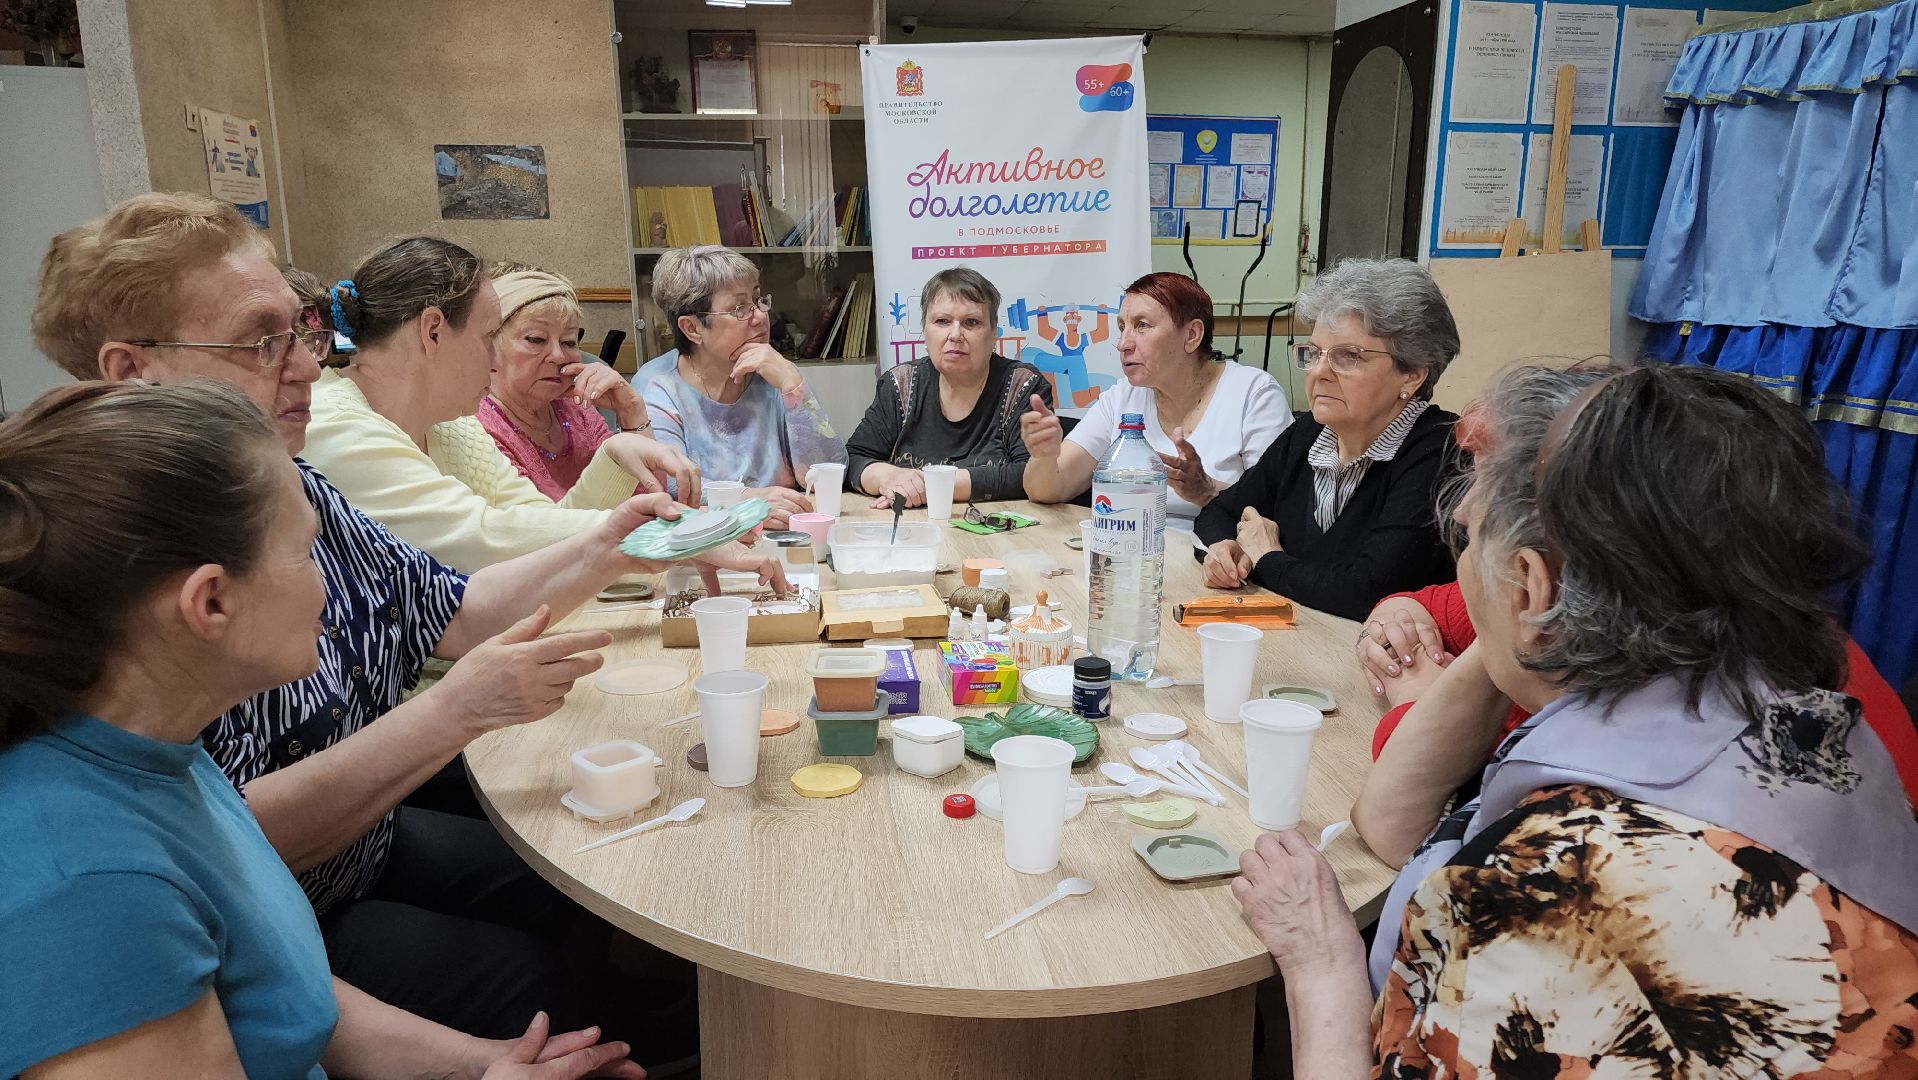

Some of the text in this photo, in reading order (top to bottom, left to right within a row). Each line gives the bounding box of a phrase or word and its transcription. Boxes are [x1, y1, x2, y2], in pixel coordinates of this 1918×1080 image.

[1084, 79, 1105, 90] 55+
[1109, 86, 1130, 97] 60+
[878, 100, 943, 109] ПРАВИТЕЛЬСТВО
[885, 108, 937, 117] МОСКОВСКОЙ
[893, 117, 929, 125] ОБЛАСТИ
[906, 146, 1106, 187] Активное
[908, 182, 1112, 218] долголетие
[958, 224, 1061, 237] В ПОДМОСКОВЬЕ
[917, 242, 1102, 258] ПРОЕКТ ГУБЕРНАТОРА
